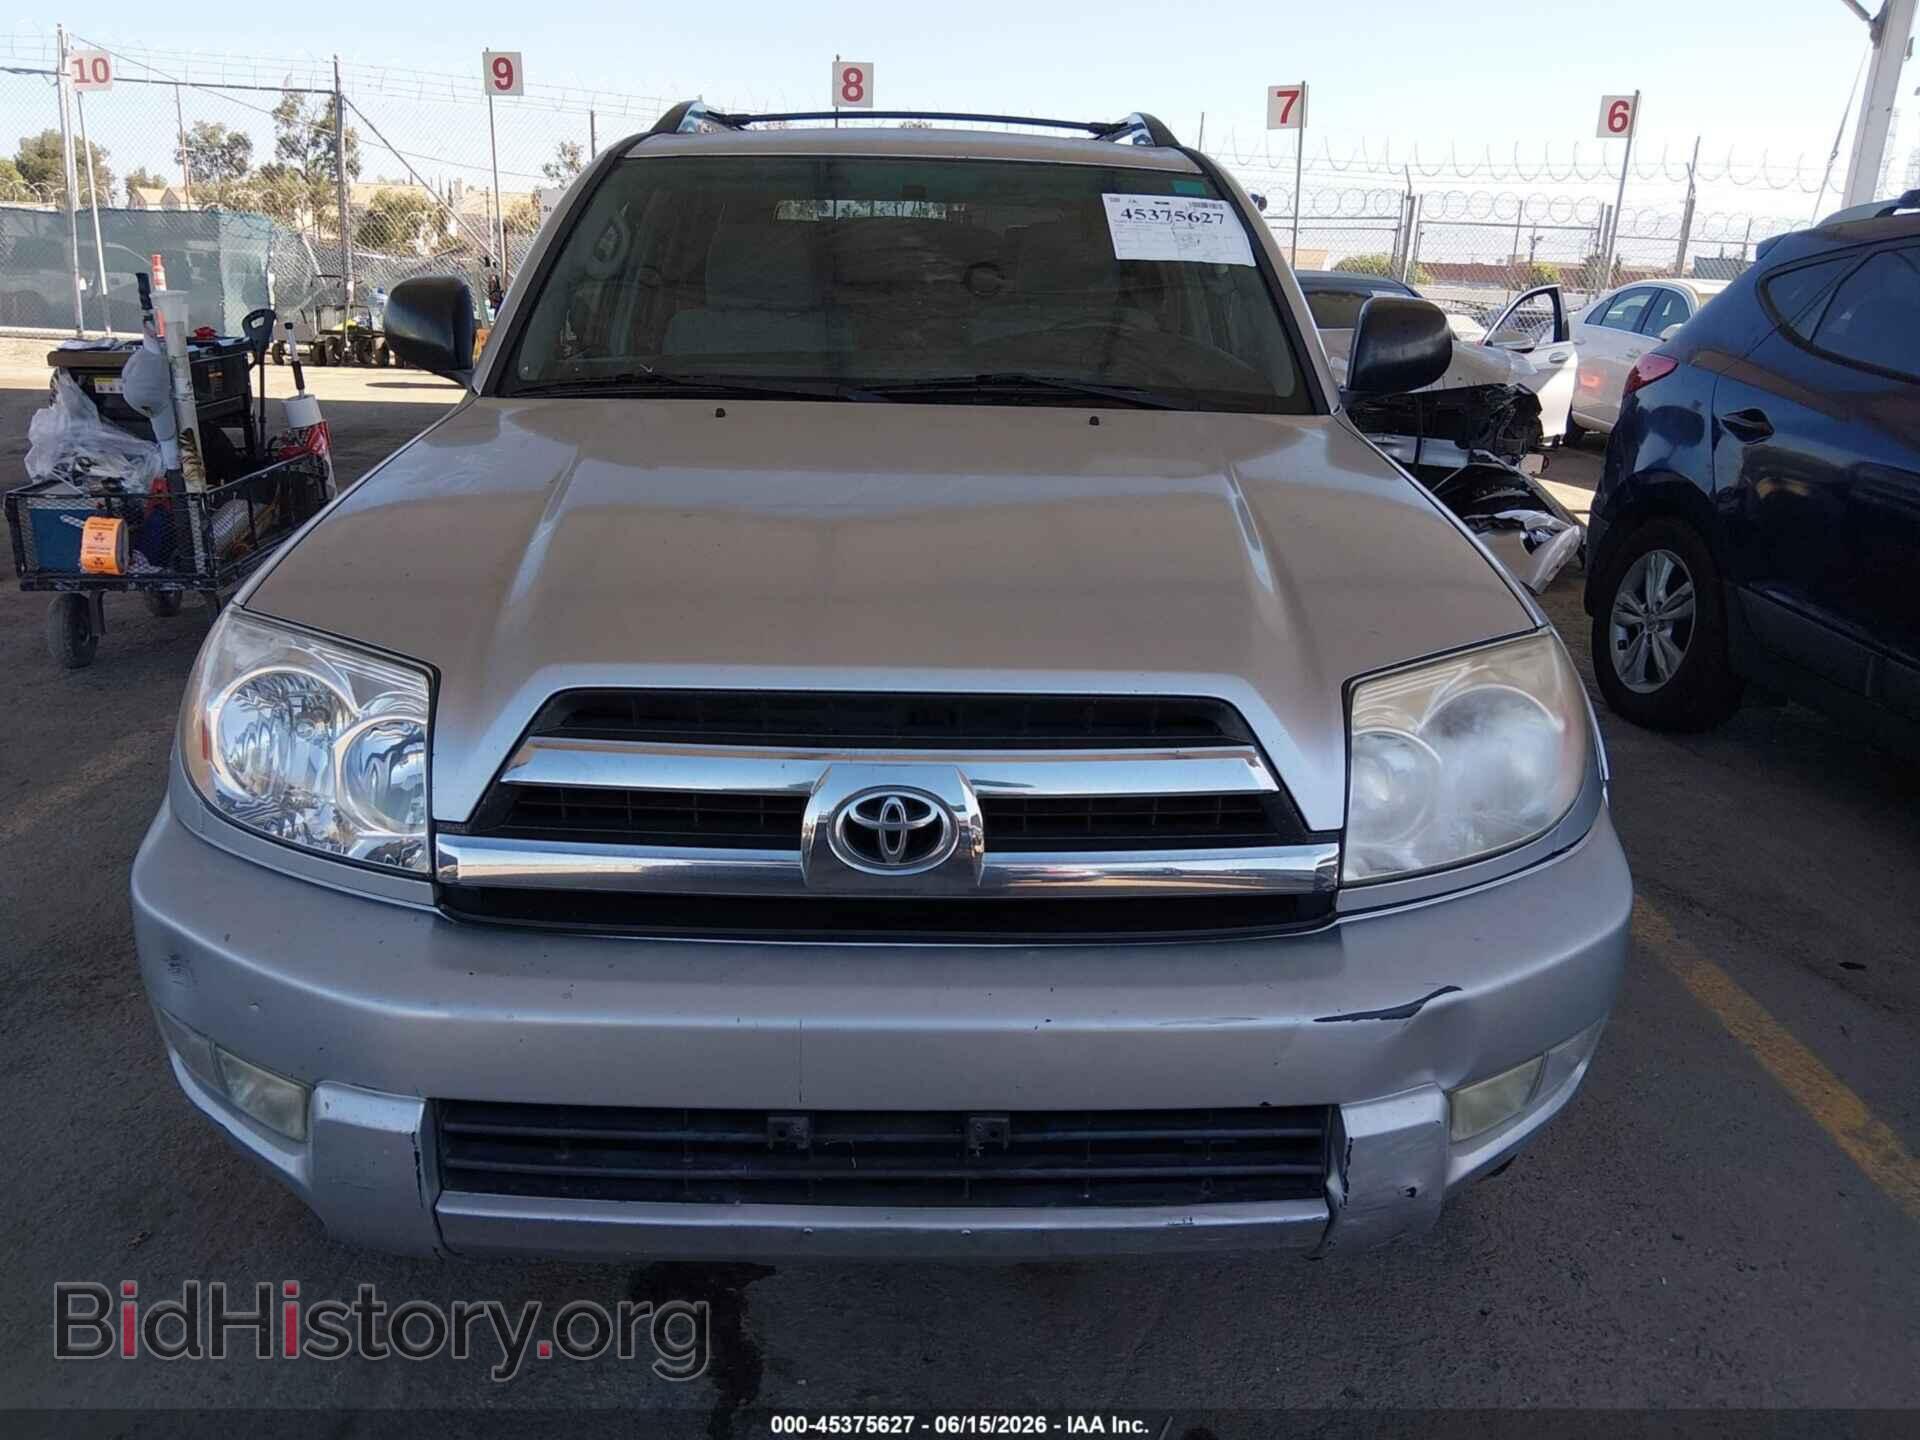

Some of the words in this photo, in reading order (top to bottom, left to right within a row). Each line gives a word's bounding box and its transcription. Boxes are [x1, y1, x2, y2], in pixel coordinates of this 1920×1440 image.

[72, 58, 109, 83] 10
[493, 57, 513, 90] 9
[842, 67, 863, 102] 8
[1277, 90, 1299, 124] 7
[1608, 100, 1629, 133] 6
[1120, 207, 1225, 225] 45375627
